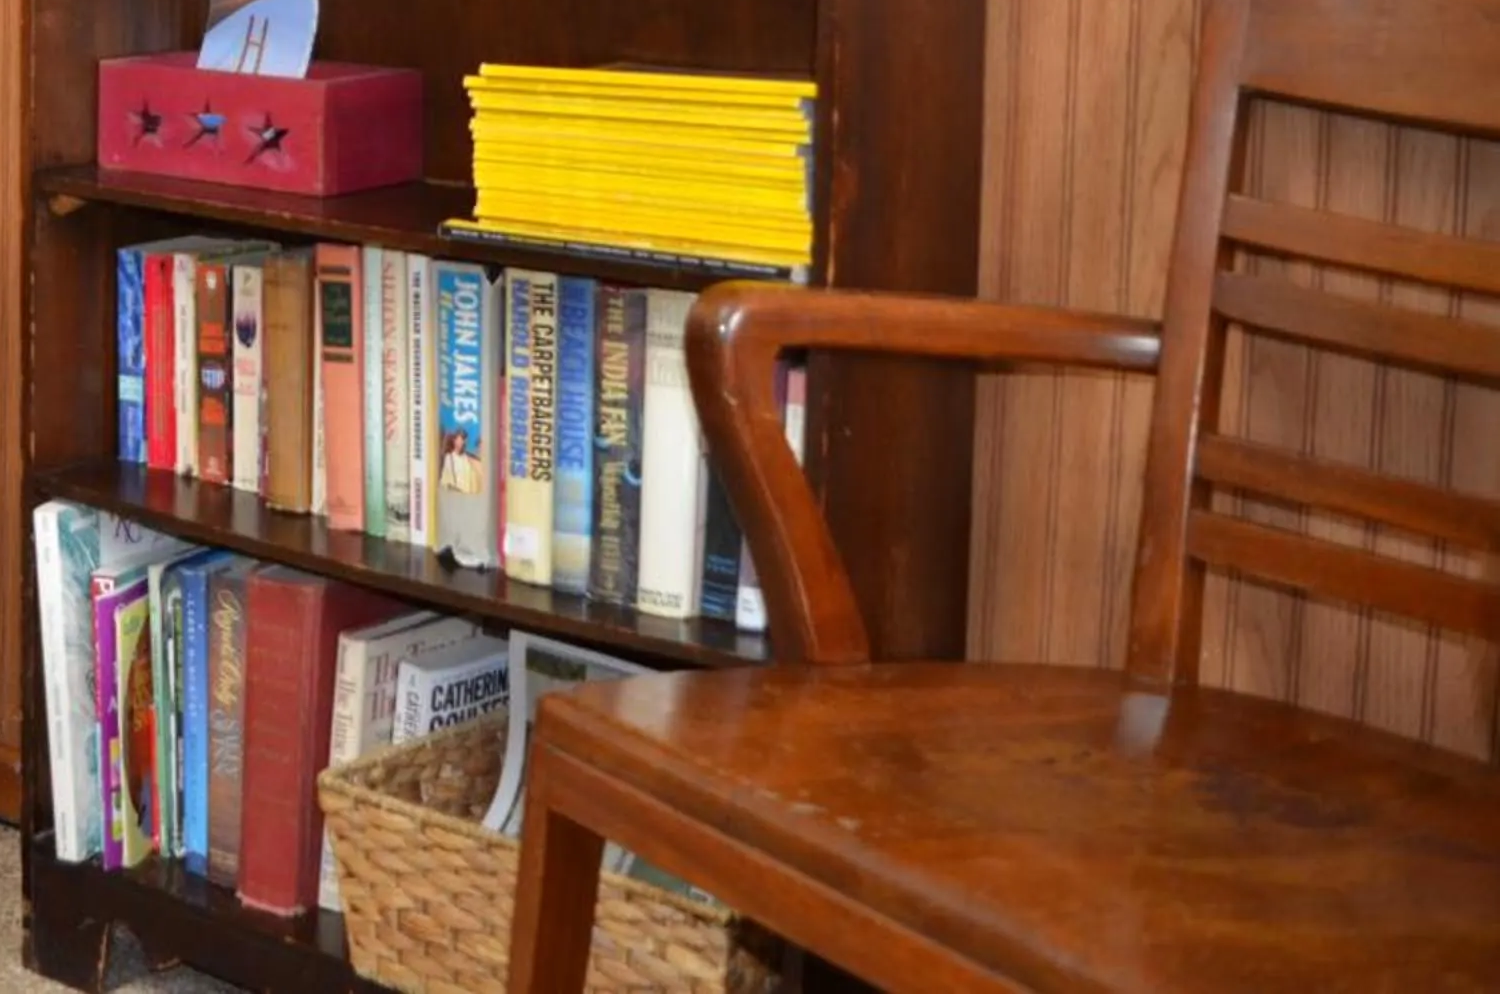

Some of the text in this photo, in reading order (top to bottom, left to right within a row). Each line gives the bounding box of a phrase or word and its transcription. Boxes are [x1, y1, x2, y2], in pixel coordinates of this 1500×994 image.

[452, 277, 480, 424] JOHN JAKES
[560, 304, 587, 382] BEACH
[607, 297, 625, 335] THE
[384, 348, 397, 443] SEASONS
[509, 279, 530, 479] HAROLD ROBBINS
[531, 282, 554, 483] THE CARPETBAGGERS
[601, 339, 630, 400] INDIA
[558, 390, 586, 472] HOUSE
[600, 406, 629, 446] FAN
[431, 667, 509, 712] CATHERIN
